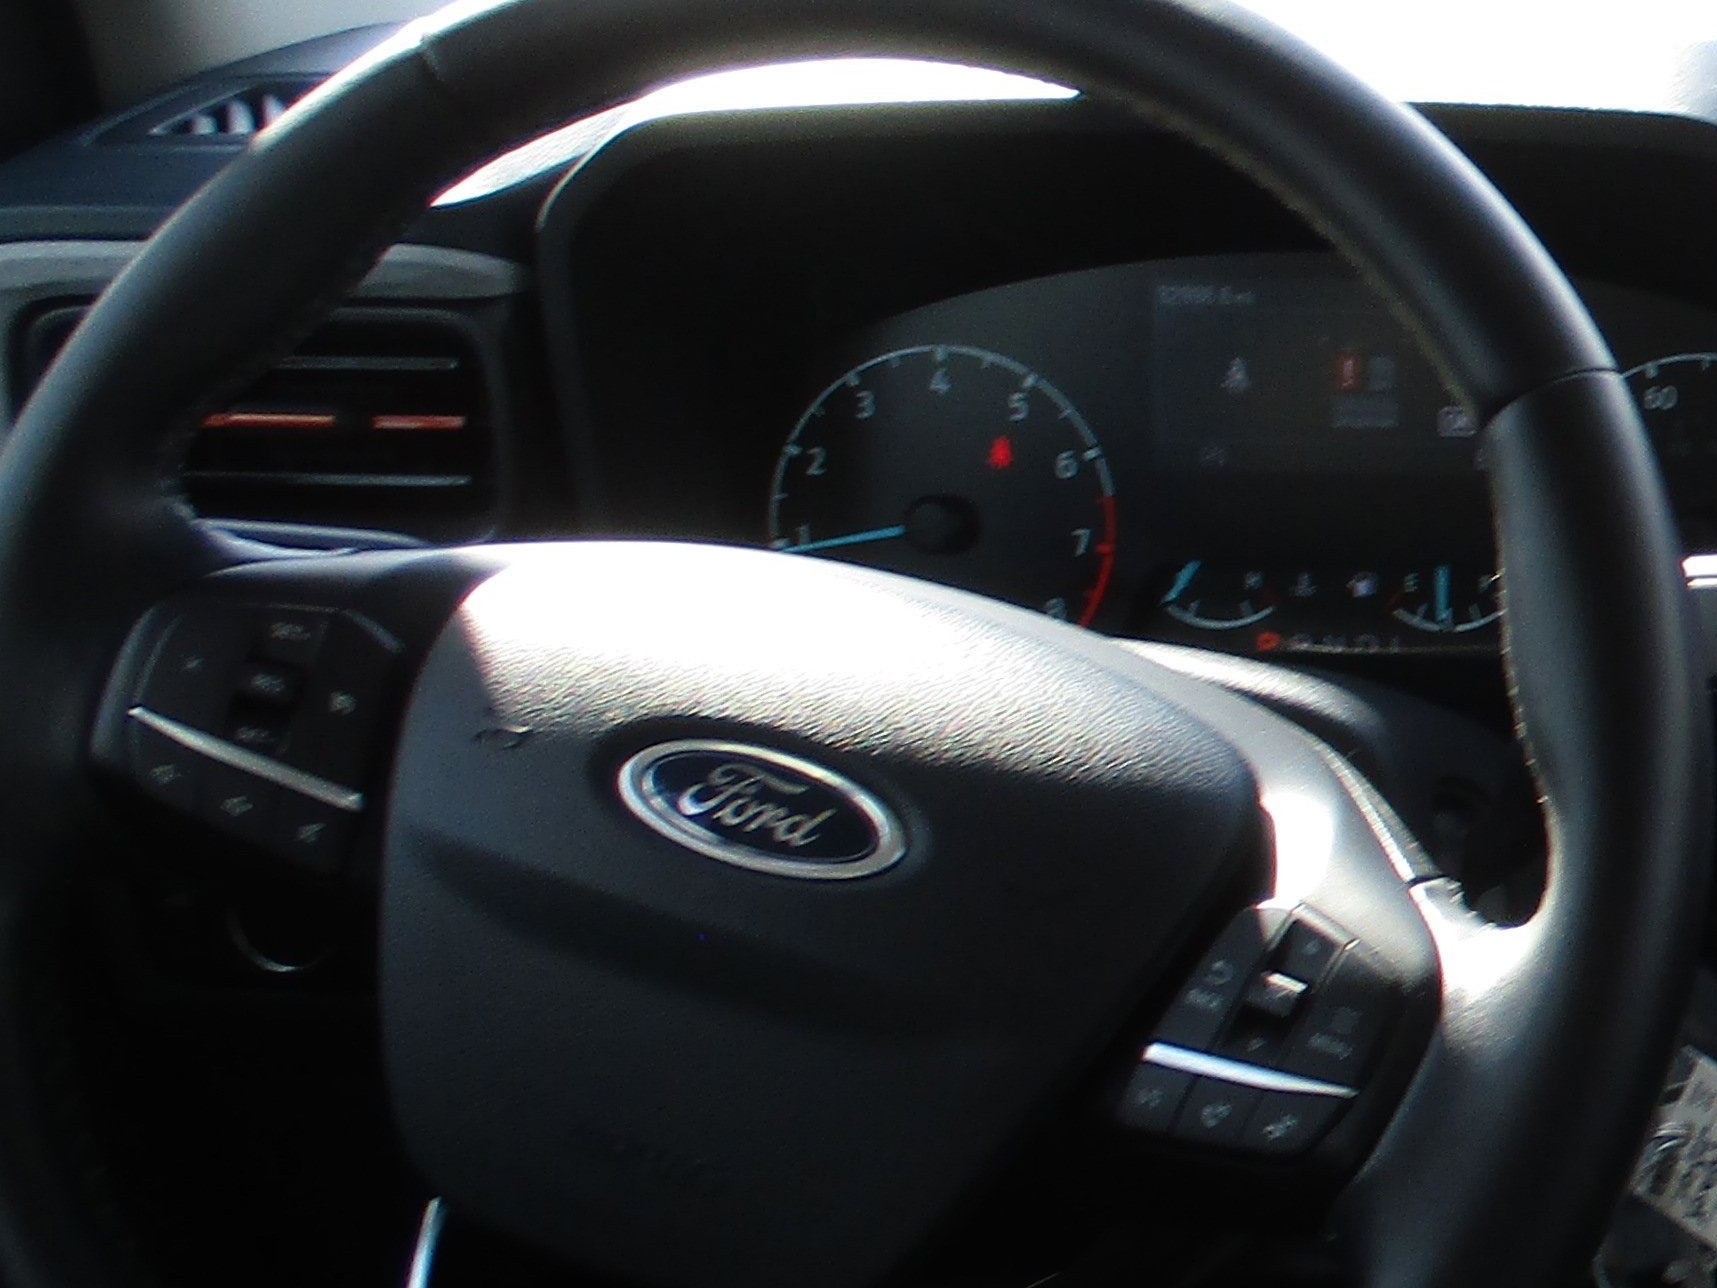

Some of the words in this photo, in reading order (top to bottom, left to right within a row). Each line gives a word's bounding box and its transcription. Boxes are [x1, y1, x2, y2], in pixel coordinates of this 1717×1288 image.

[931, 368, 951, 395] 4
[856, 389, 877, 420] 3
[1009, 392, 1031, 423] 5
[806, 446, 828, 477] 2
[1056, 449, 1079, 480] 6
[1071, 529, 1091, 558] 7
[677, 762, 838, 847] Ford
